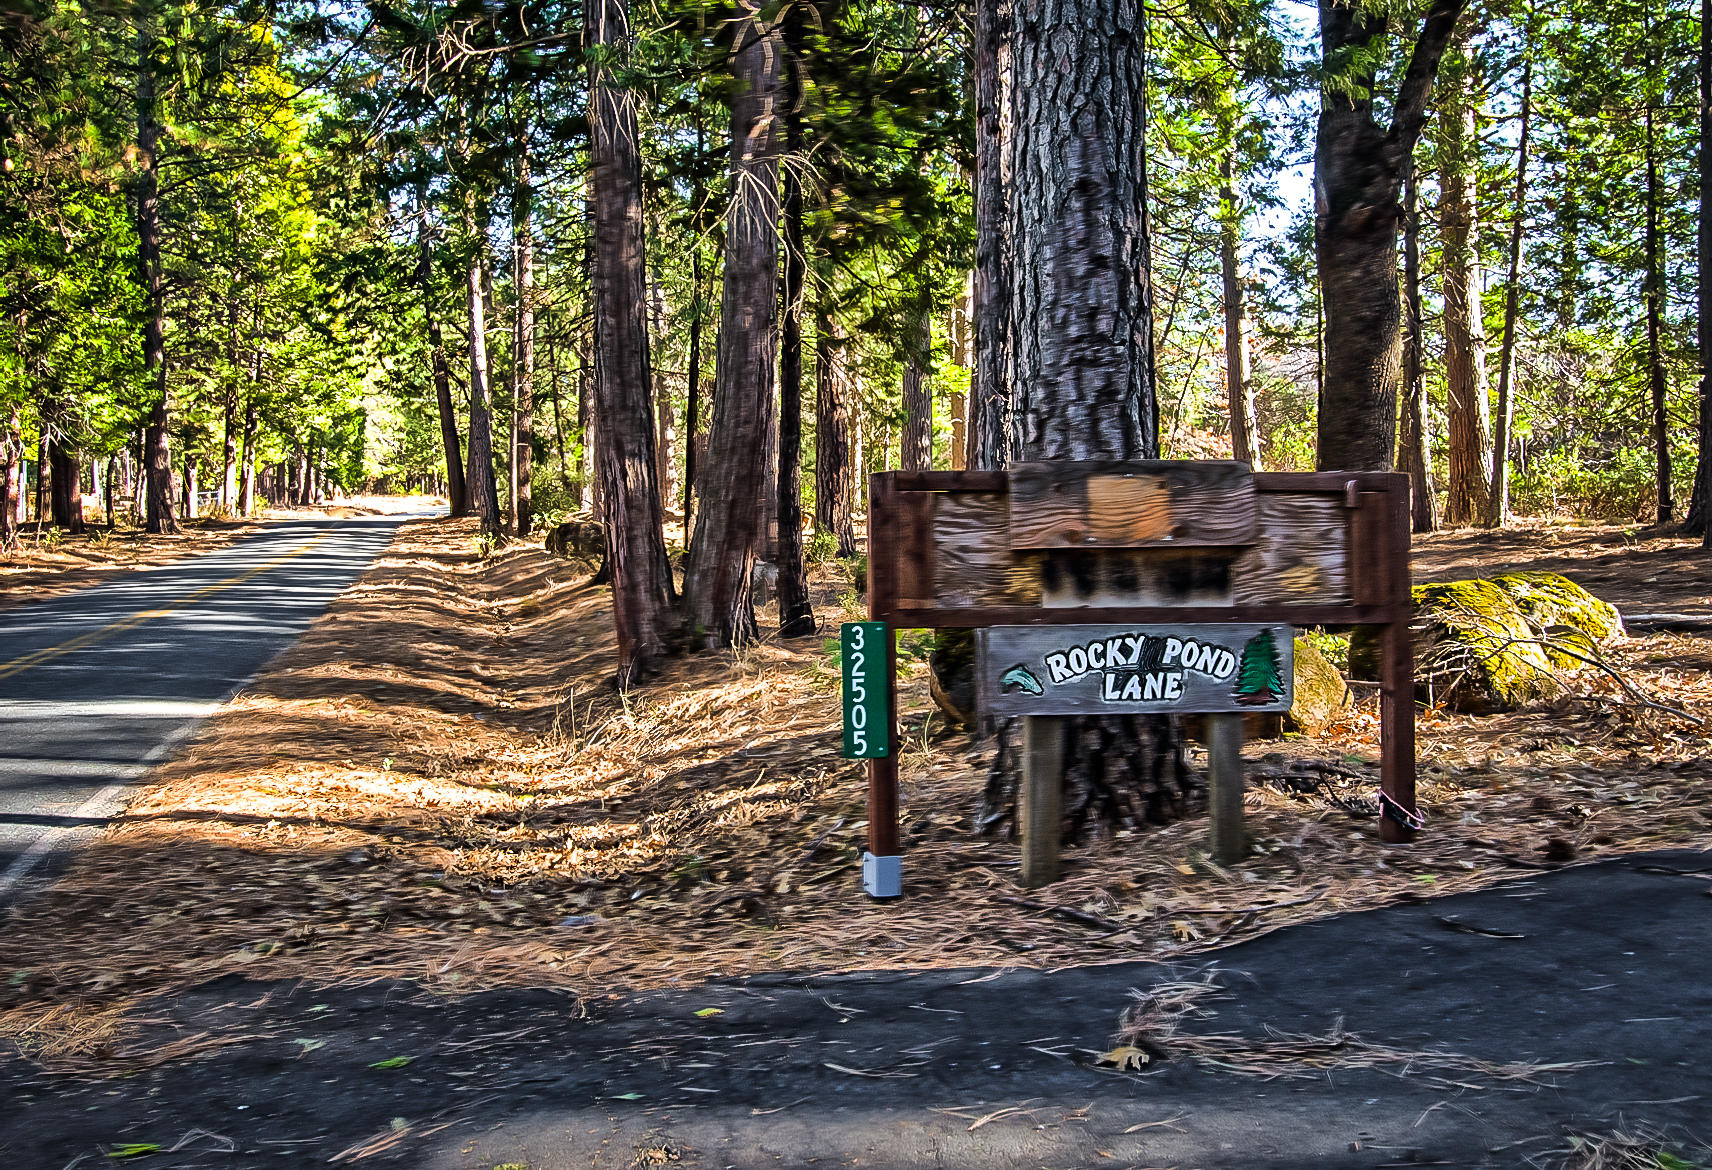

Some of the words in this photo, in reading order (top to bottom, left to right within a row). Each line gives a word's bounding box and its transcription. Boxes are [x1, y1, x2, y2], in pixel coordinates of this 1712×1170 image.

[1046, 636, 1145, 682] ROCKY
[1163, 638, 1235, 678] POND
[851, 626, 867, 756] 32505
[1104, 672, 1182, 700] LANE
